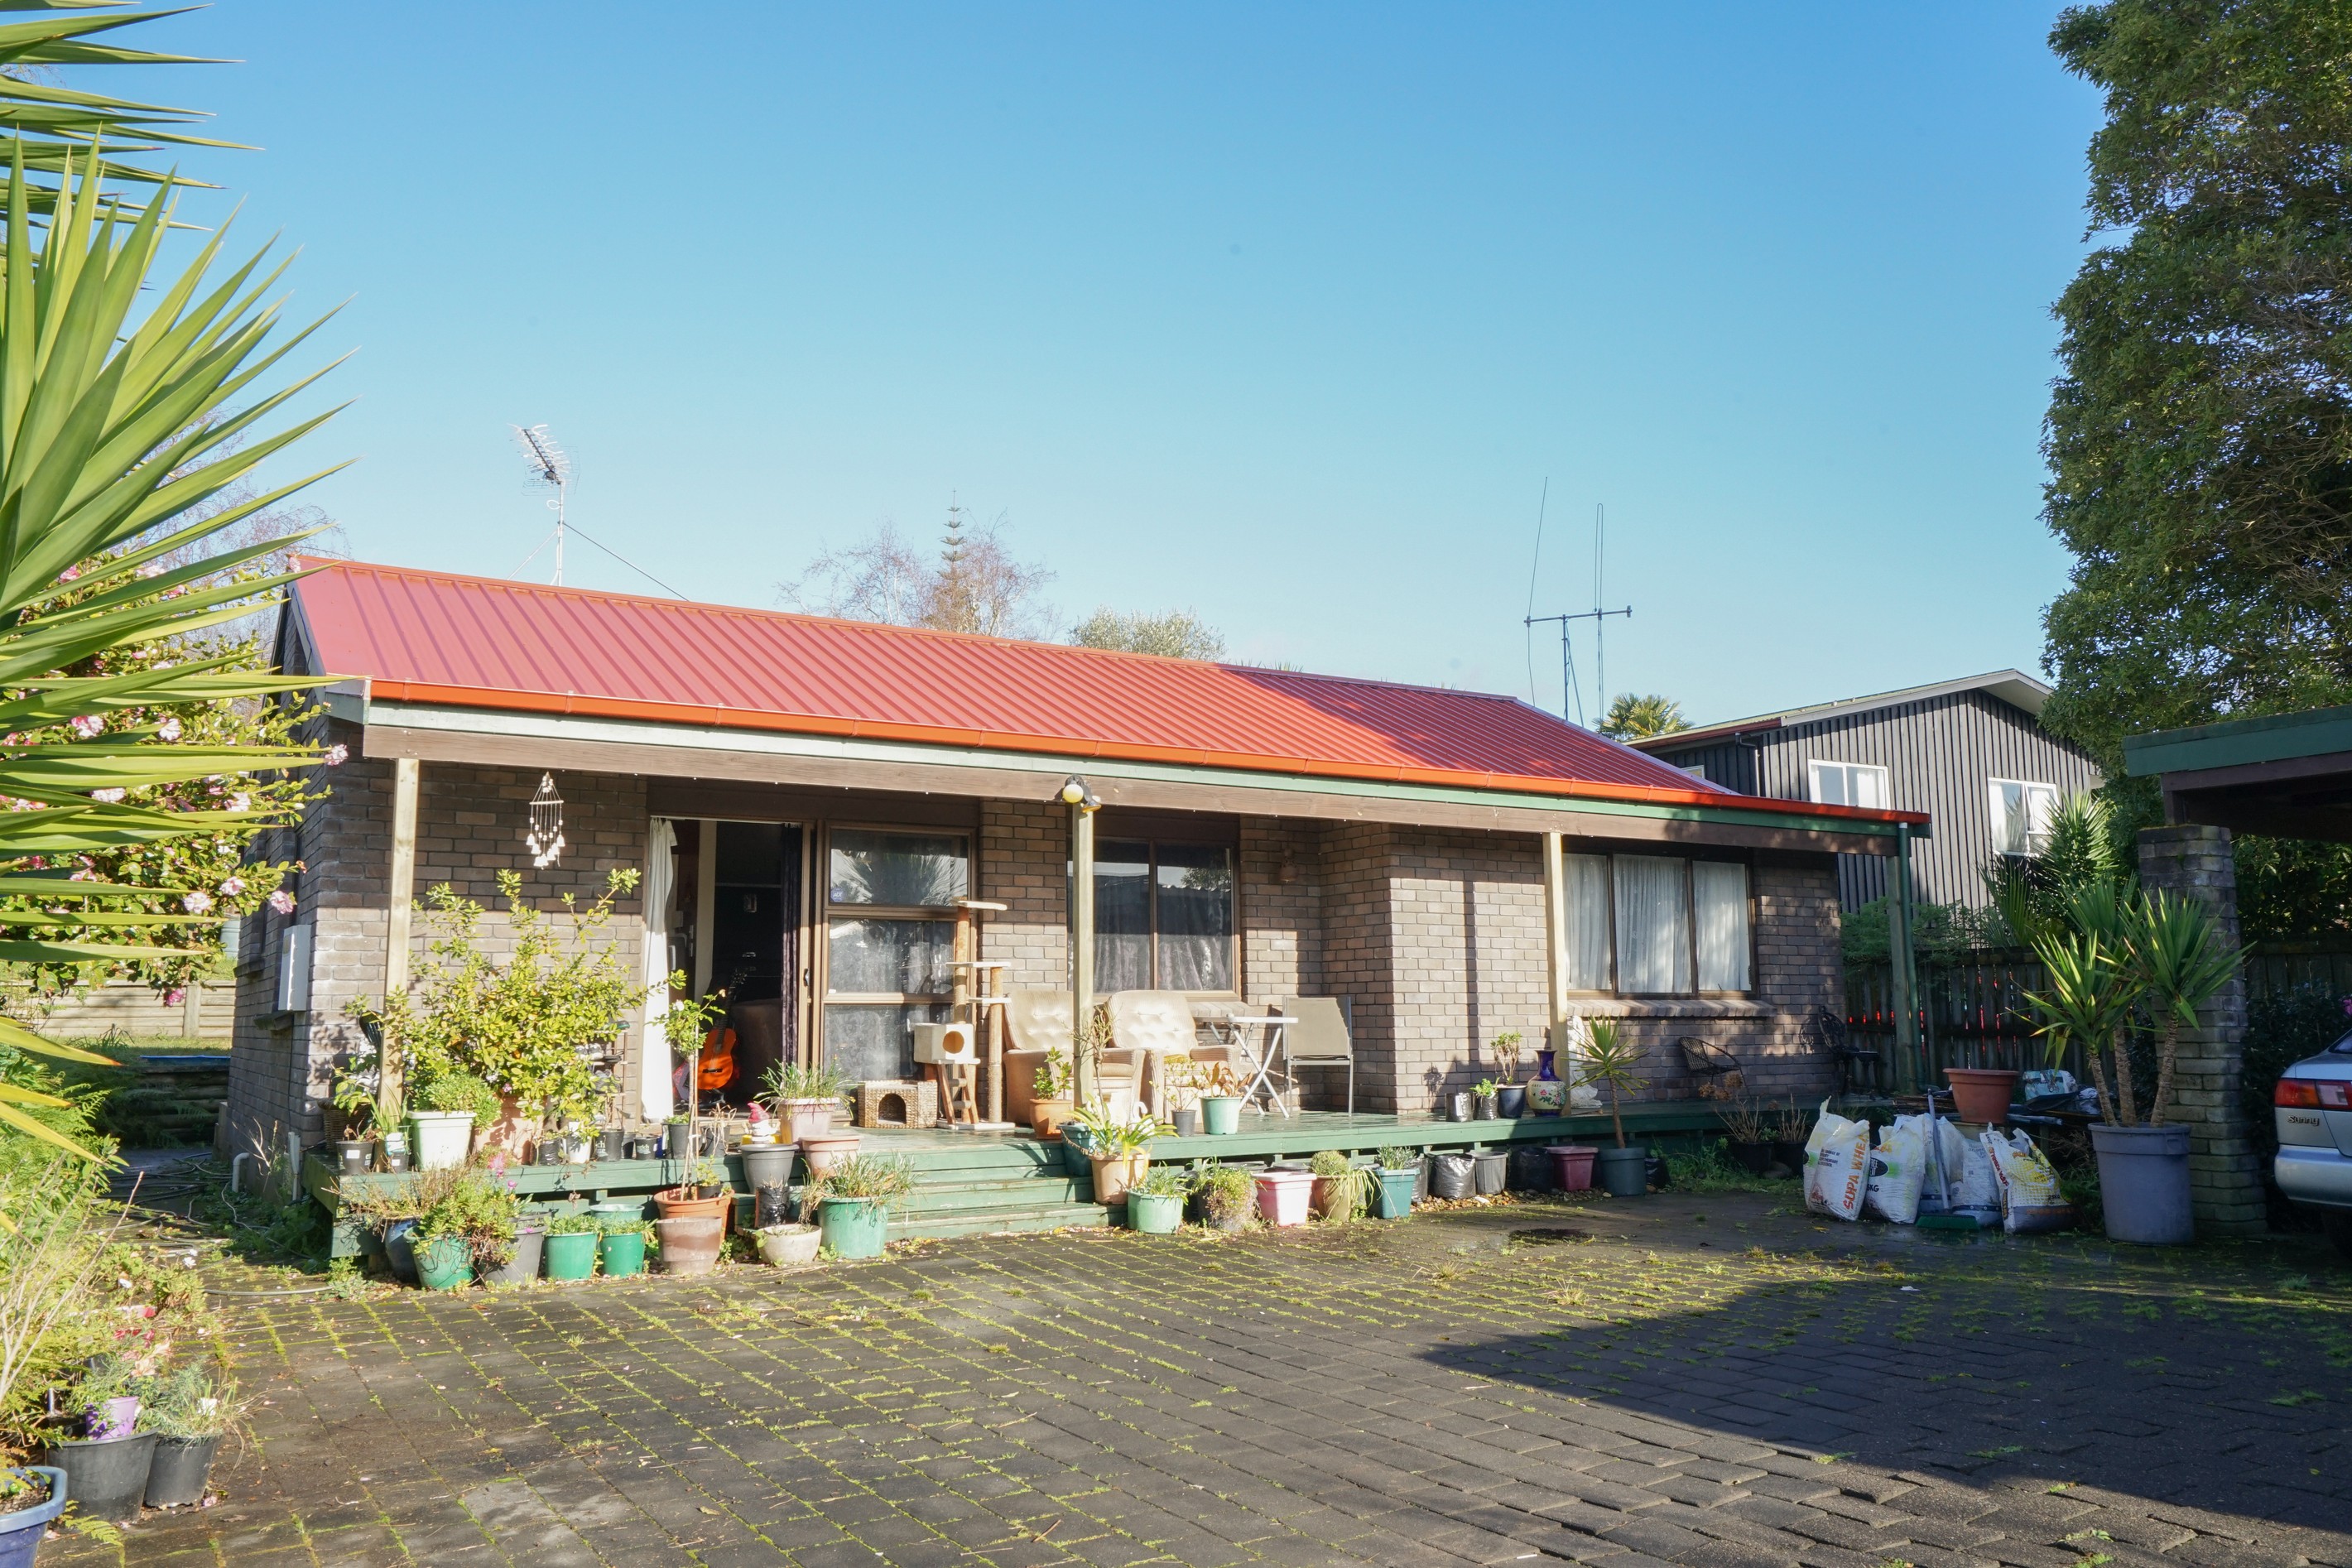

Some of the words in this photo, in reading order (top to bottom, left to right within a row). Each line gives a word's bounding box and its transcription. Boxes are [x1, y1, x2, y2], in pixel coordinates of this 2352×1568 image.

[2287, 1114, 2320, 1127] Sunny
[1851, 1134, 1869, 1170] WHEA
[1844, 1175, 1859, 1210] SUPA
[1867, 1184, 1879, 1192] 5KG
